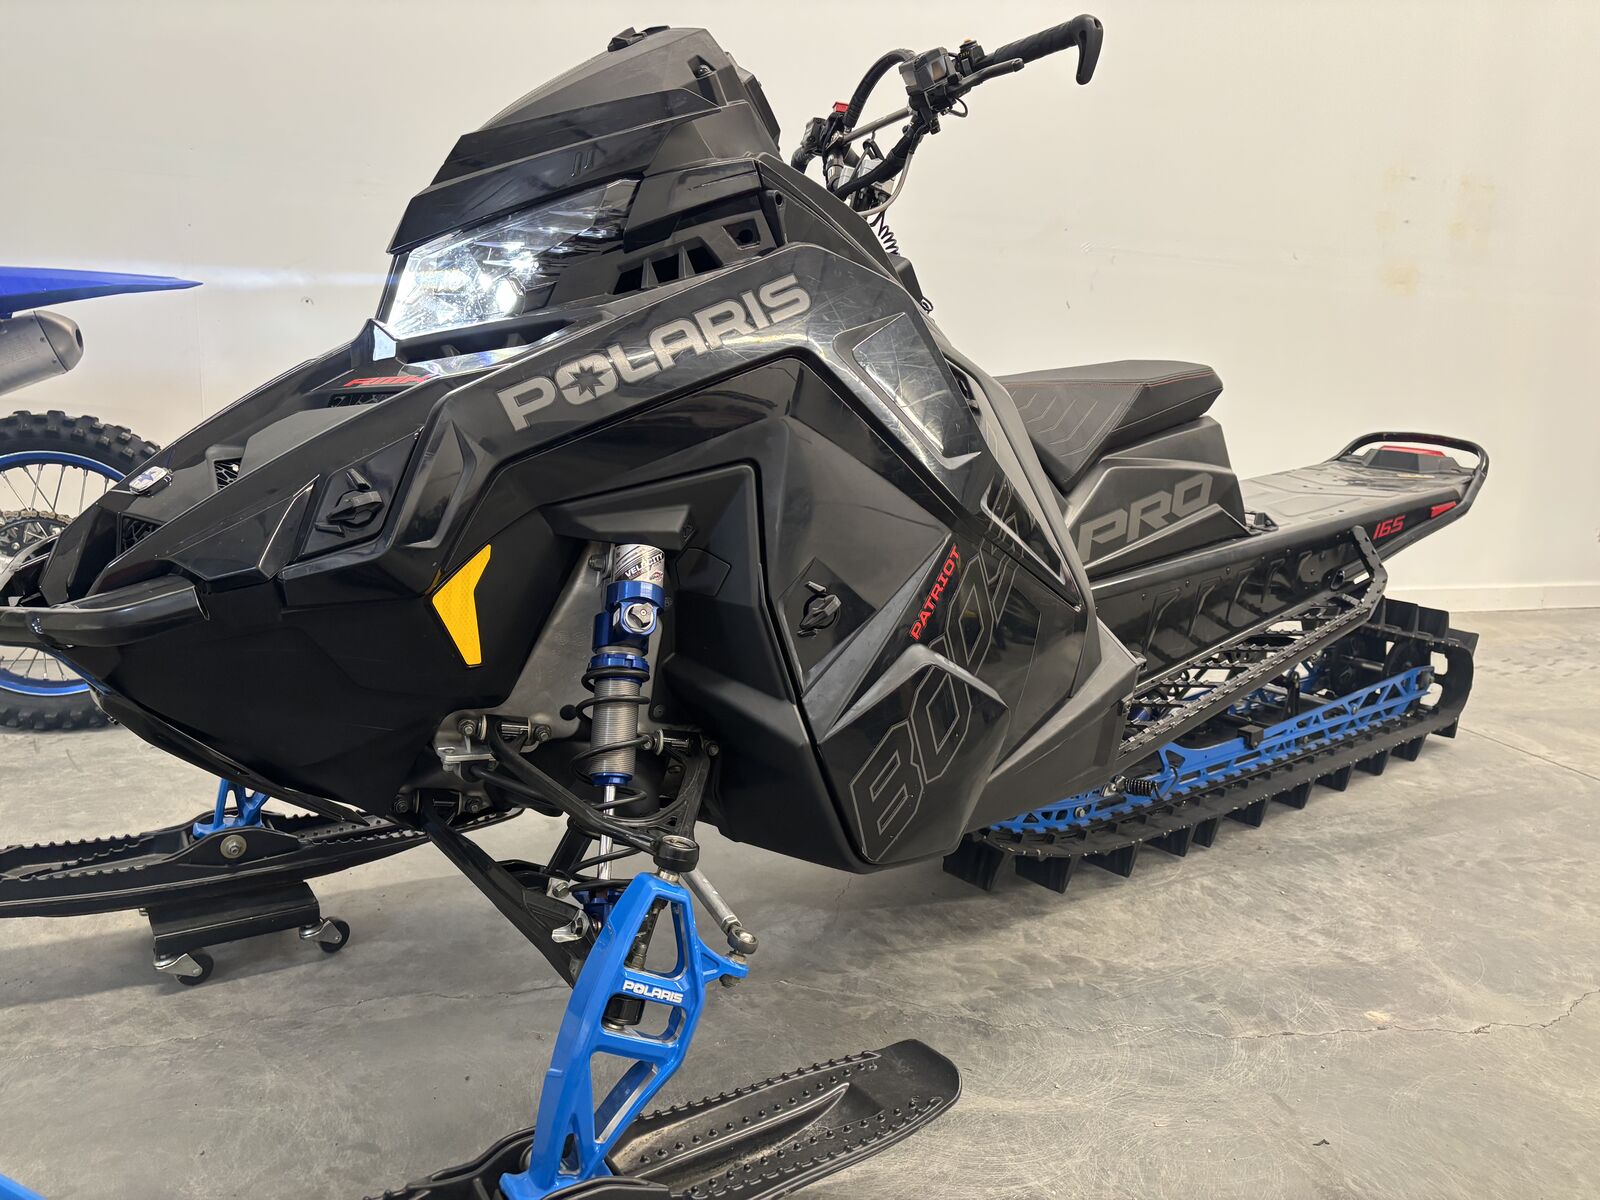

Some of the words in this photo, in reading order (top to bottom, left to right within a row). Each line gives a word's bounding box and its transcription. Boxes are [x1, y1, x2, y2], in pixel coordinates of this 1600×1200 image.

[497, 273, 811, 431] POLARIS
[1077, 473, 1213, 562] PRO
[1373, 515, 1406, 540] 165
[911, 545, 960, 640] PATRIOT
[623, 980, 684, 1004] POLARIS
